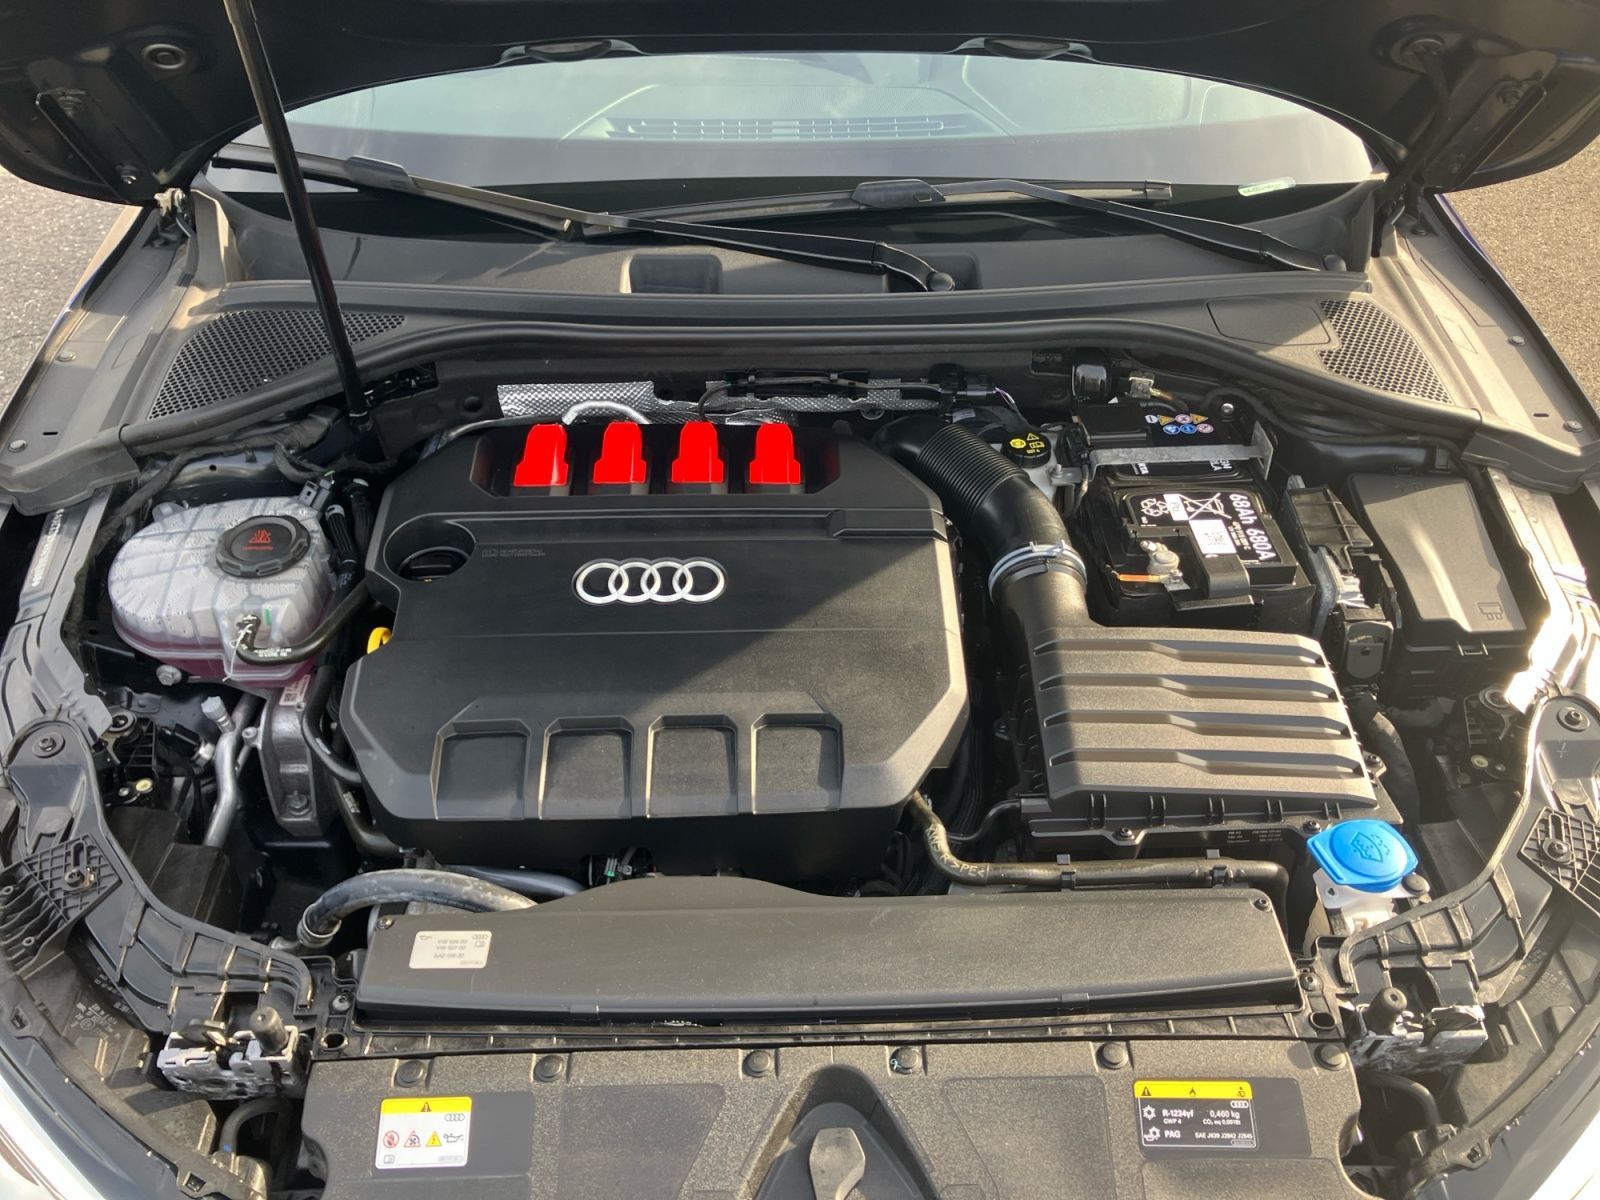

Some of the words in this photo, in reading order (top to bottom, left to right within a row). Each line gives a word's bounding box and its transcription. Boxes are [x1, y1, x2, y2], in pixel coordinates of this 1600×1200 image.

[1229, 493, 1254, 525] 68Ah
[1246, 528, 1276, 561] 680A
[1162, 1109, 1194, 1119] R-1234yf
[1231, 1110, 1240, 1120] kg
[1164, 1129, 1181, 1139] PAG
